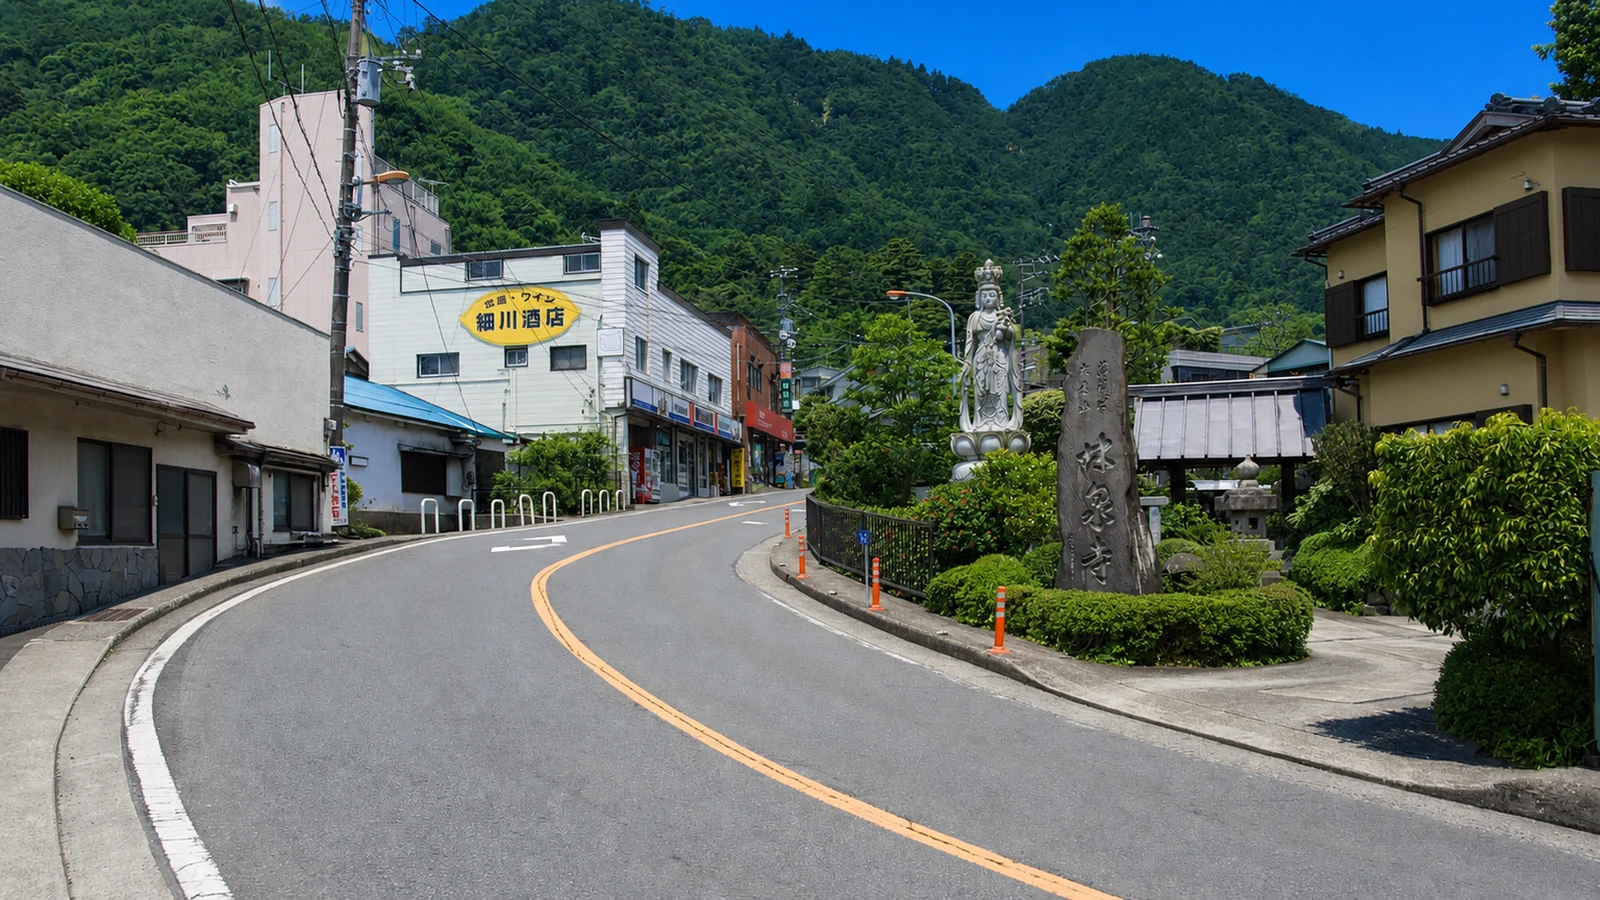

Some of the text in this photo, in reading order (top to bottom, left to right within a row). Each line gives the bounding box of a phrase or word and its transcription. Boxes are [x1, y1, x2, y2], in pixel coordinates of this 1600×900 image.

[476, 306, 565, 332] 細川酒店
[1075, 432, 1117, 585] 林泉寺
